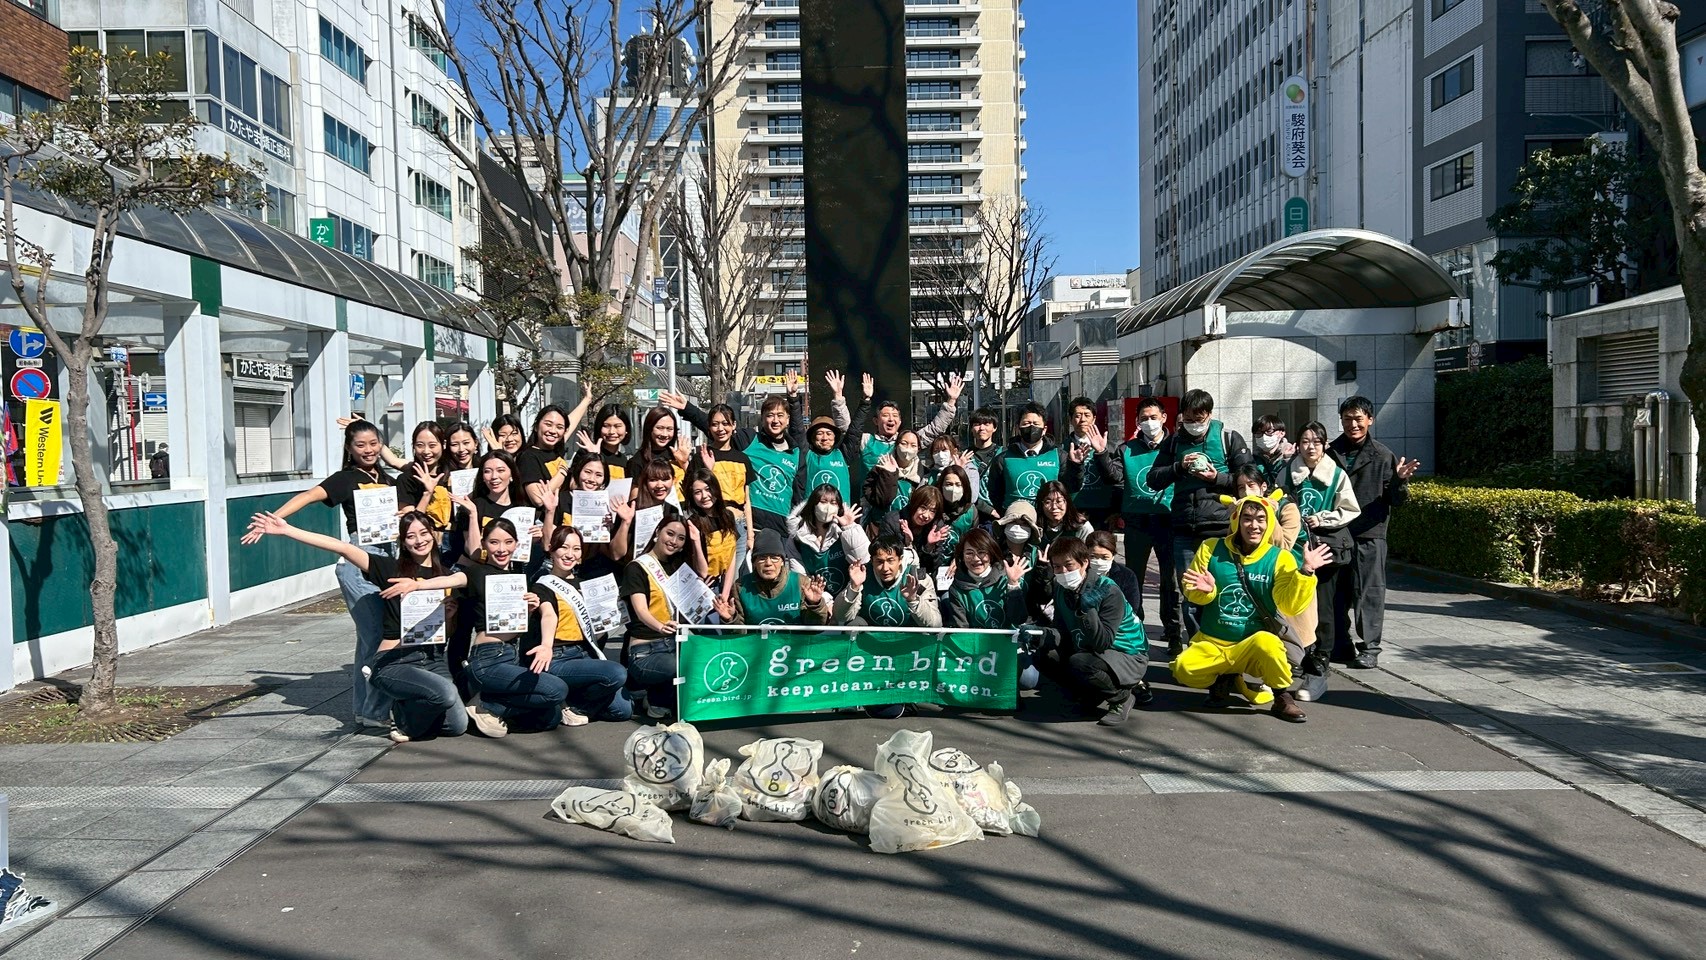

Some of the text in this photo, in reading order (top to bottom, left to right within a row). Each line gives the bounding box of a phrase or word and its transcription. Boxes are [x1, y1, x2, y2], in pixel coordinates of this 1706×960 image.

[229, 115, 291, 162] かたやま矯正歯科
[1291, 113, 1306, 169] 駿府葵会
[37, 427, 49, 469] Western
[549, 579, 572, 595] MISS
[1248, 572, 1270, 583] UACJ
[777, 602, 800, 612] UACJ
[768, 645, 998, 677] green bird
[767, 680, 998, 697] keep clean, keep green.
